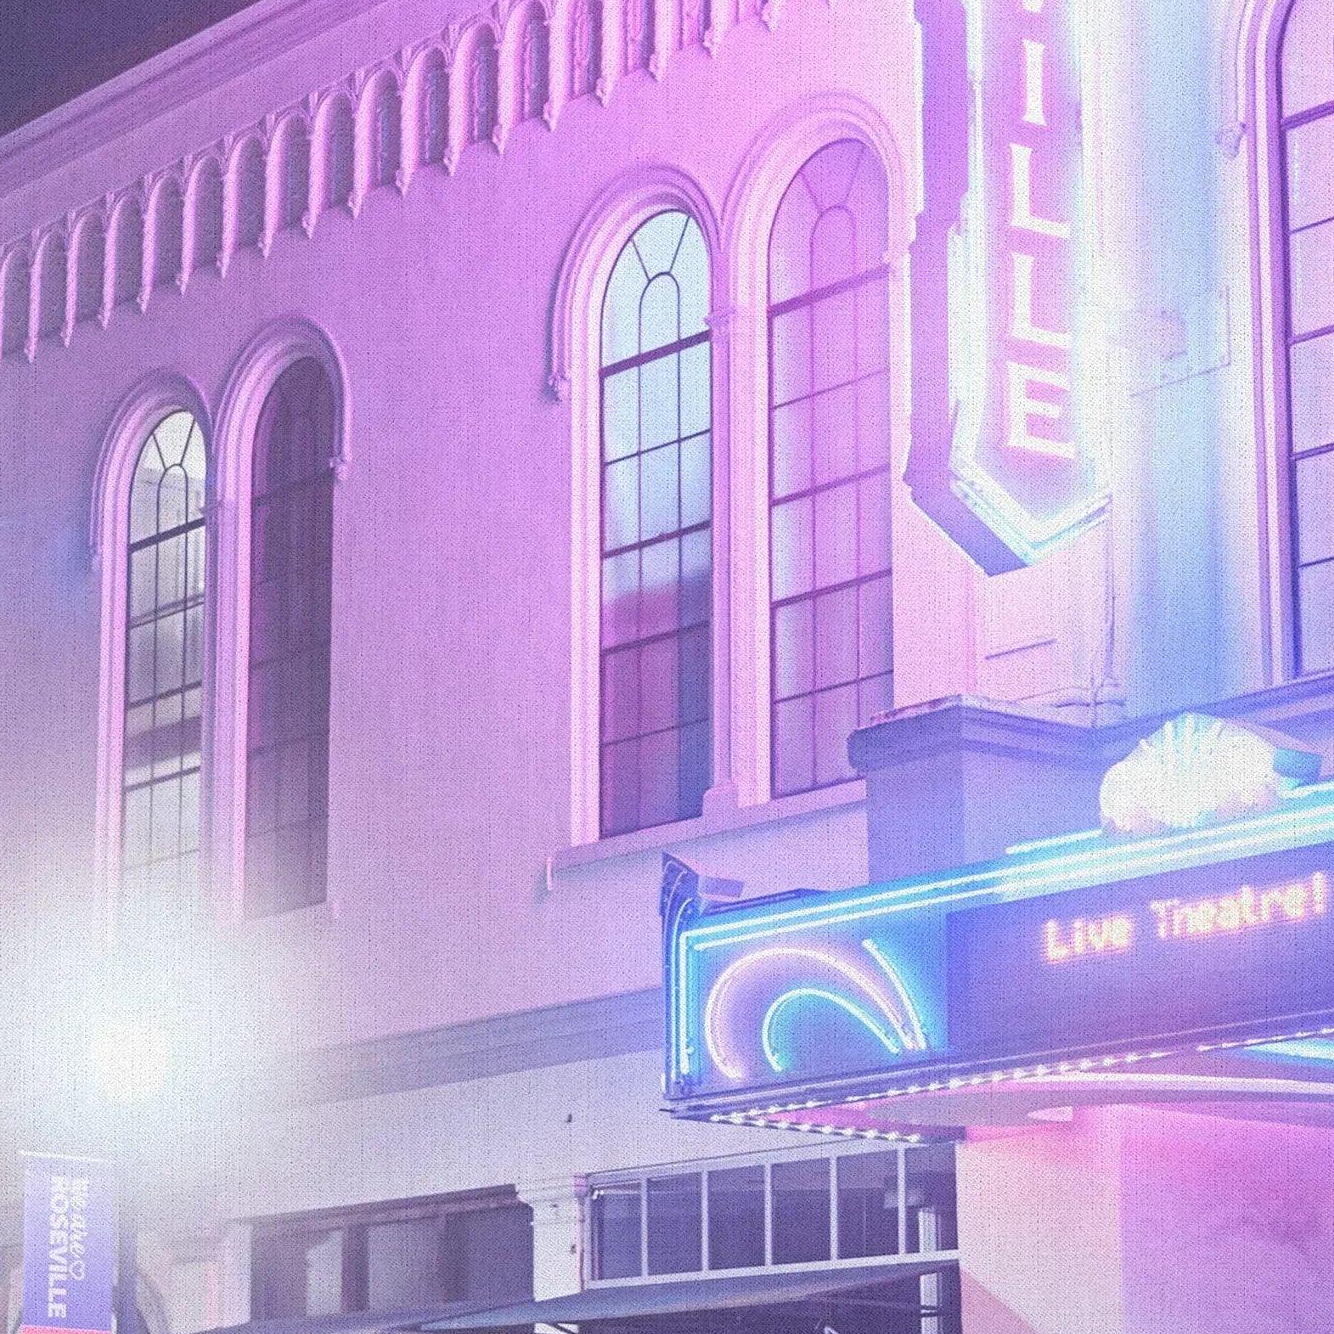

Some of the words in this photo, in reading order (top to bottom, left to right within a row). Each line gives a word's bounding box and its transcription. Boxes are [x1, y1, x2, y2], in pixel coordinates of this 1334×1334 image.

[1043, 913, 1133, 961] Live
[1149, 870, 1328, 938] Theatre!
[47, 1175, 70, 1319] ROSEVILLE
